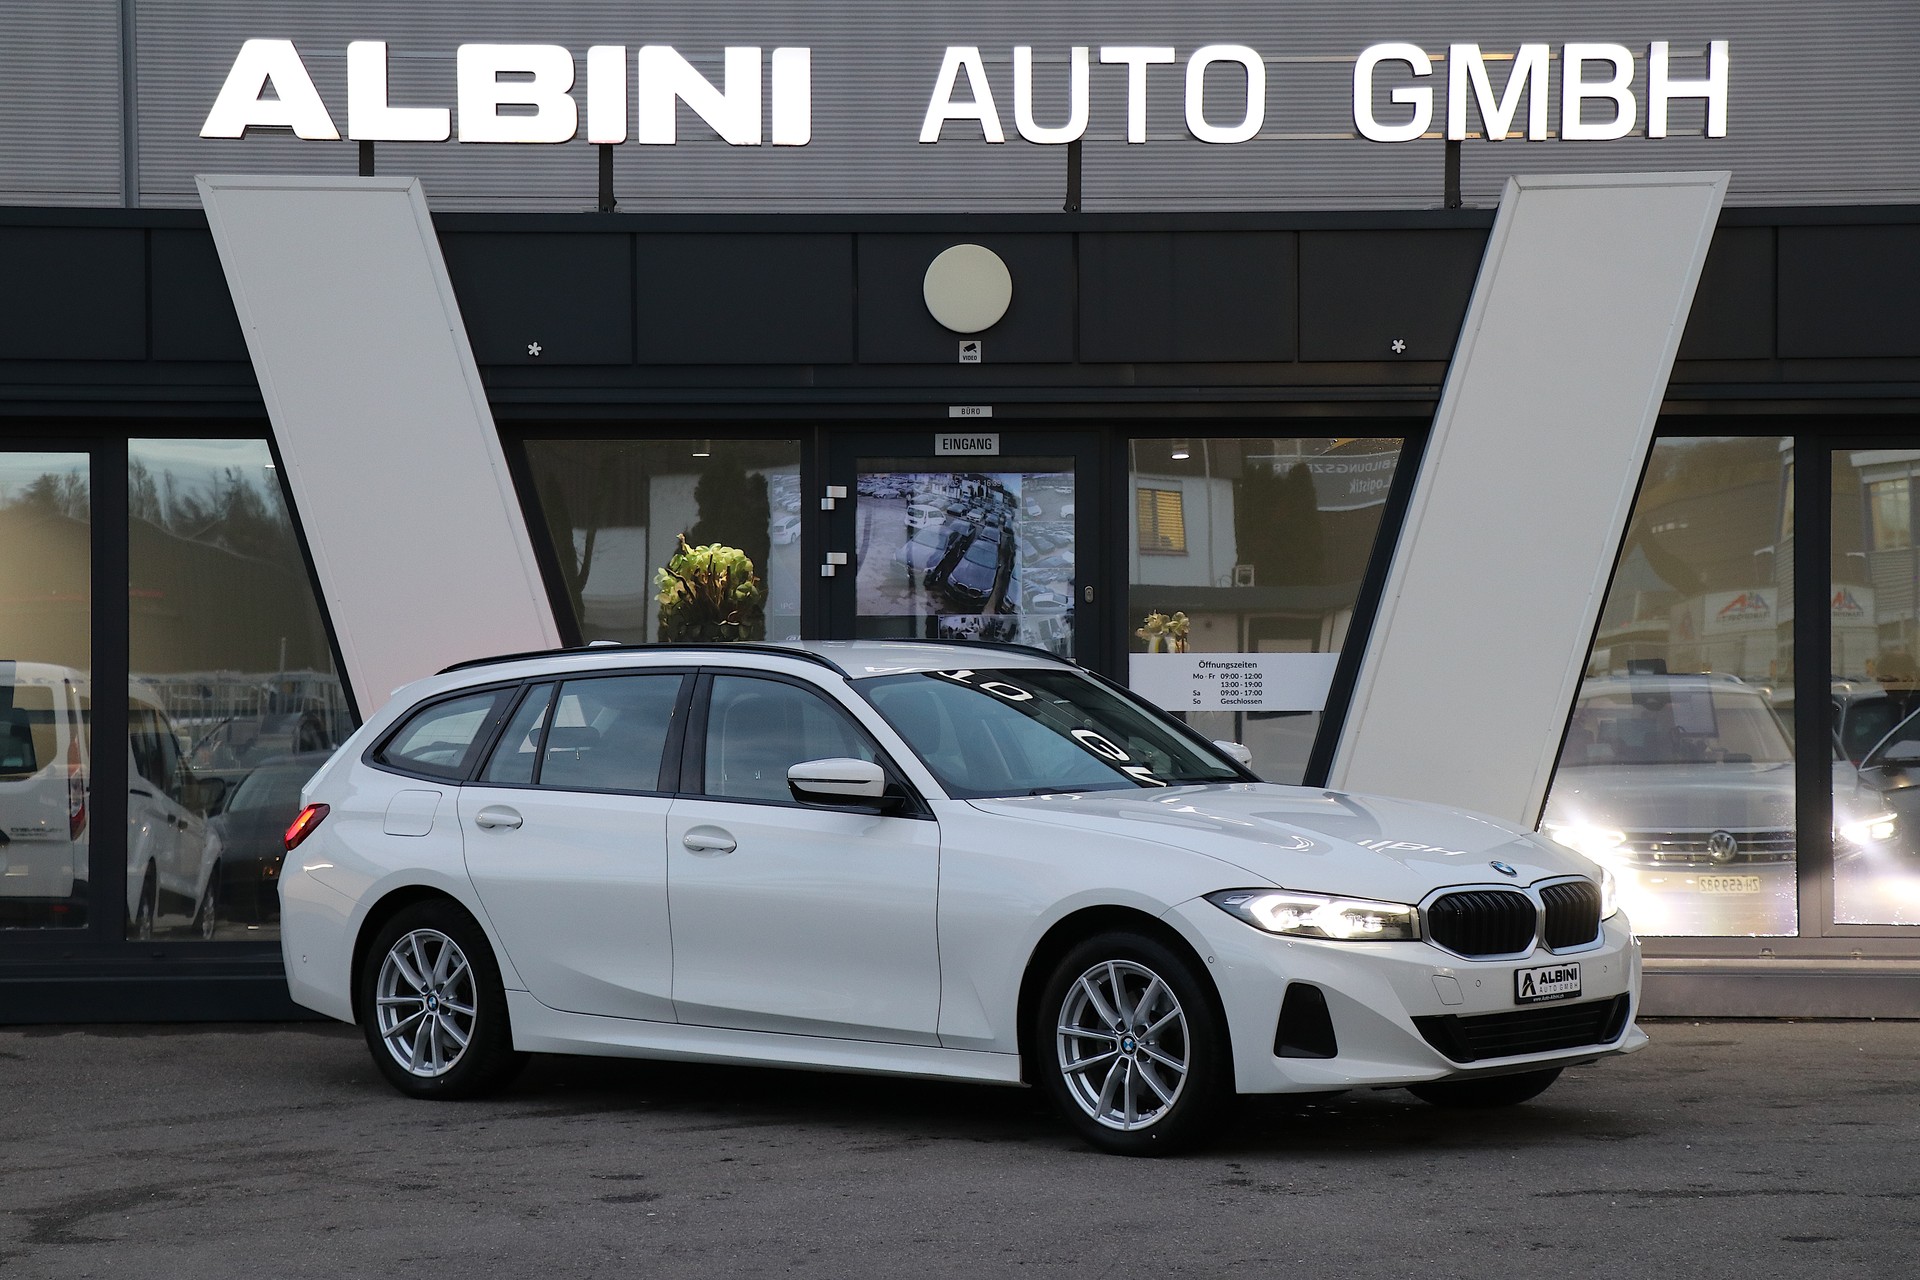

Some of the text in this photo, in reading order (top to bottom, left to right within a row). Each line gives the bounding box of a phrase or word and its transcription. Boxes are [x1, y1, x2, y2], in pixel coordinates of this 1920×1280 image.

[199, 38, 1729, 146] ALBINI AUTO GMBH
[961, 406, 981, 415] BÜRO
[942, 438, 992, 450] EINGANG
[1198, 660, 1257, 669] Öffnungszeiten
[1539, 968, 1577, 985] ALBINI
[1539, 982, 1578, 993] AUTO GMBH
